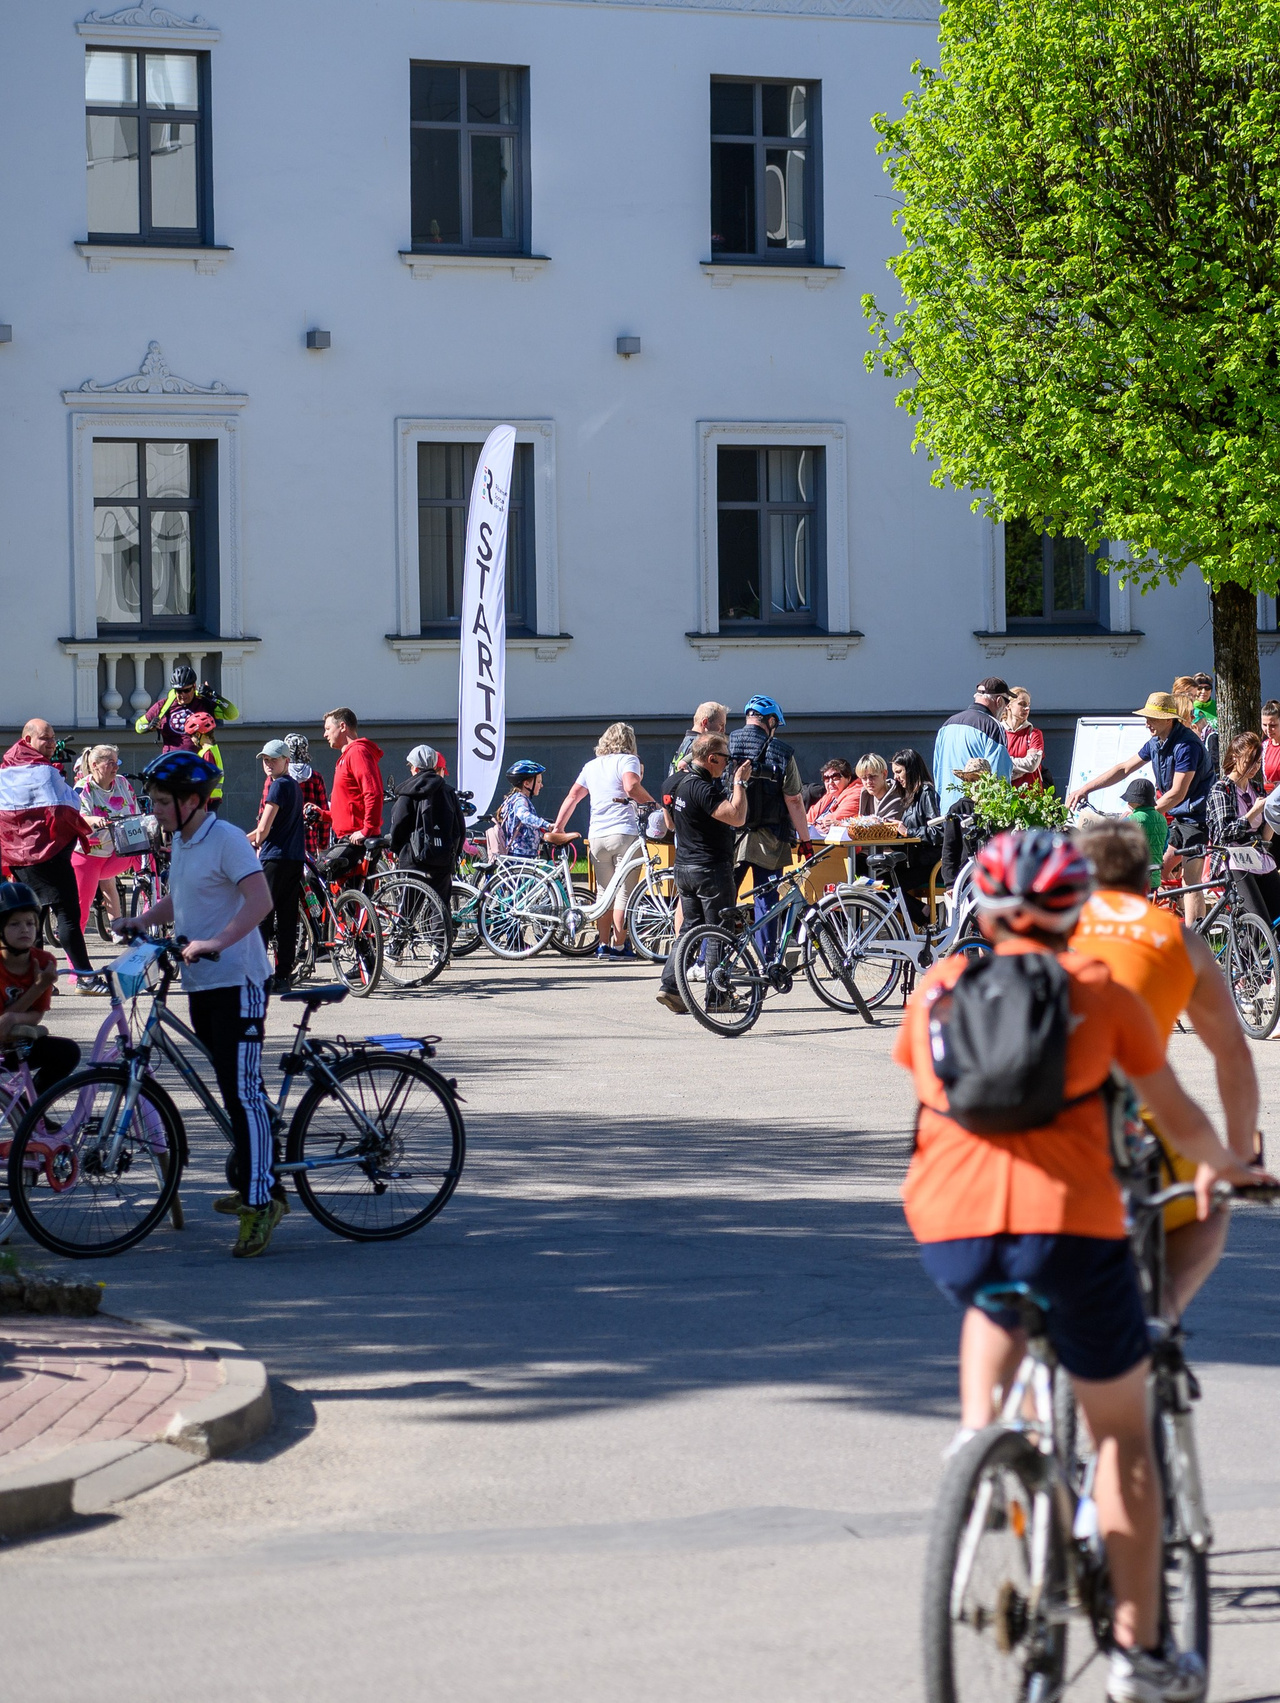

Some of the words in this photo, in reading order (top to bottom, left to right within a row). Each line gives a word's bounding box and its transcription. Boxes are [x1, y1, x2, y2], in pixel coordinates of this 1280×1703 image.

[472, 521, 497, 762] STARTS
[127, 828, 142, 837] 504
[1083, 923, 1168, 949] INITY
